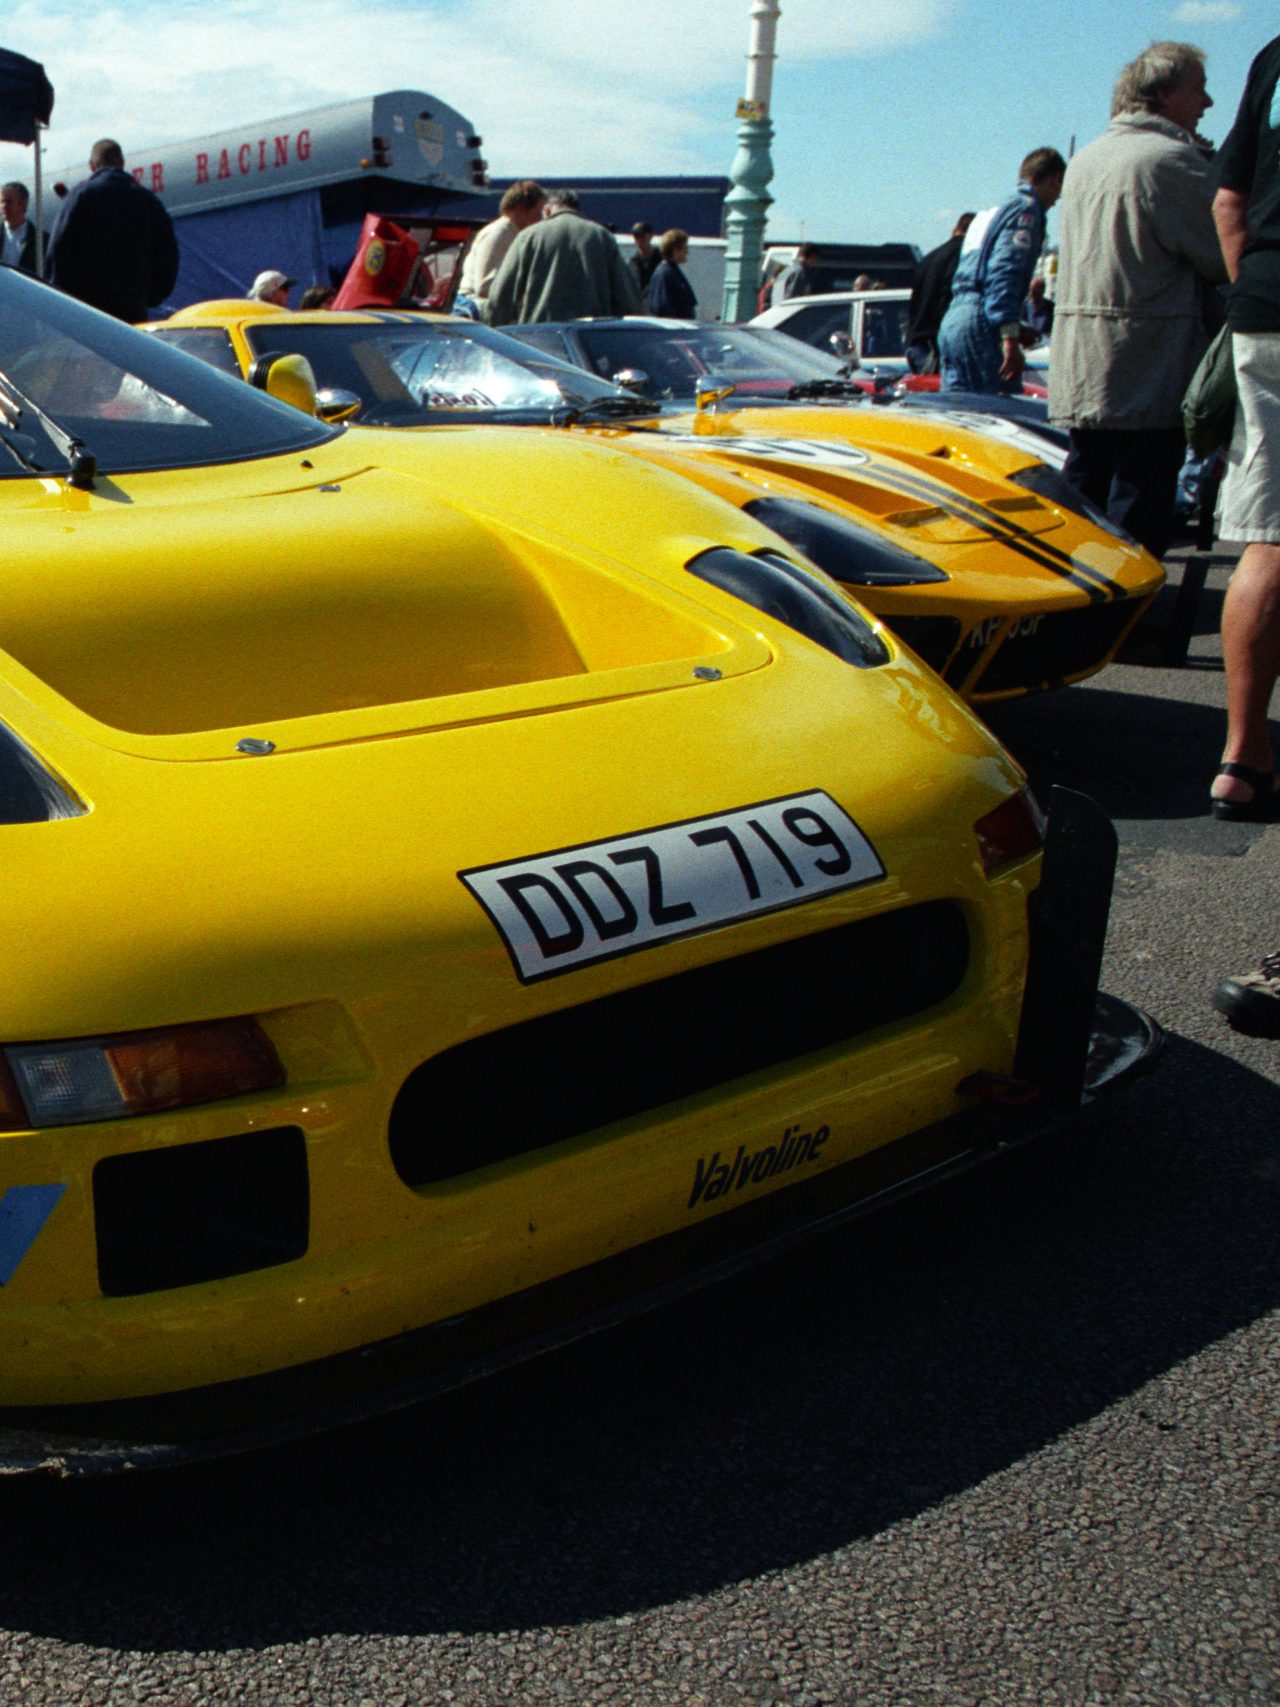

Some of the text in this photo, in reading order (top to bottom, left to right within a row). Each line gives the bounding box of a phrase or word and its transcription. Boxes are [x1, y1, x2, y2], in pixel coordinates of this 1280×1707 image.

[195, 129, 312, 185] RACING
[496, 806, 852, 959] DDZ 719
[687, 1124, 831, 1209] Valvoline
